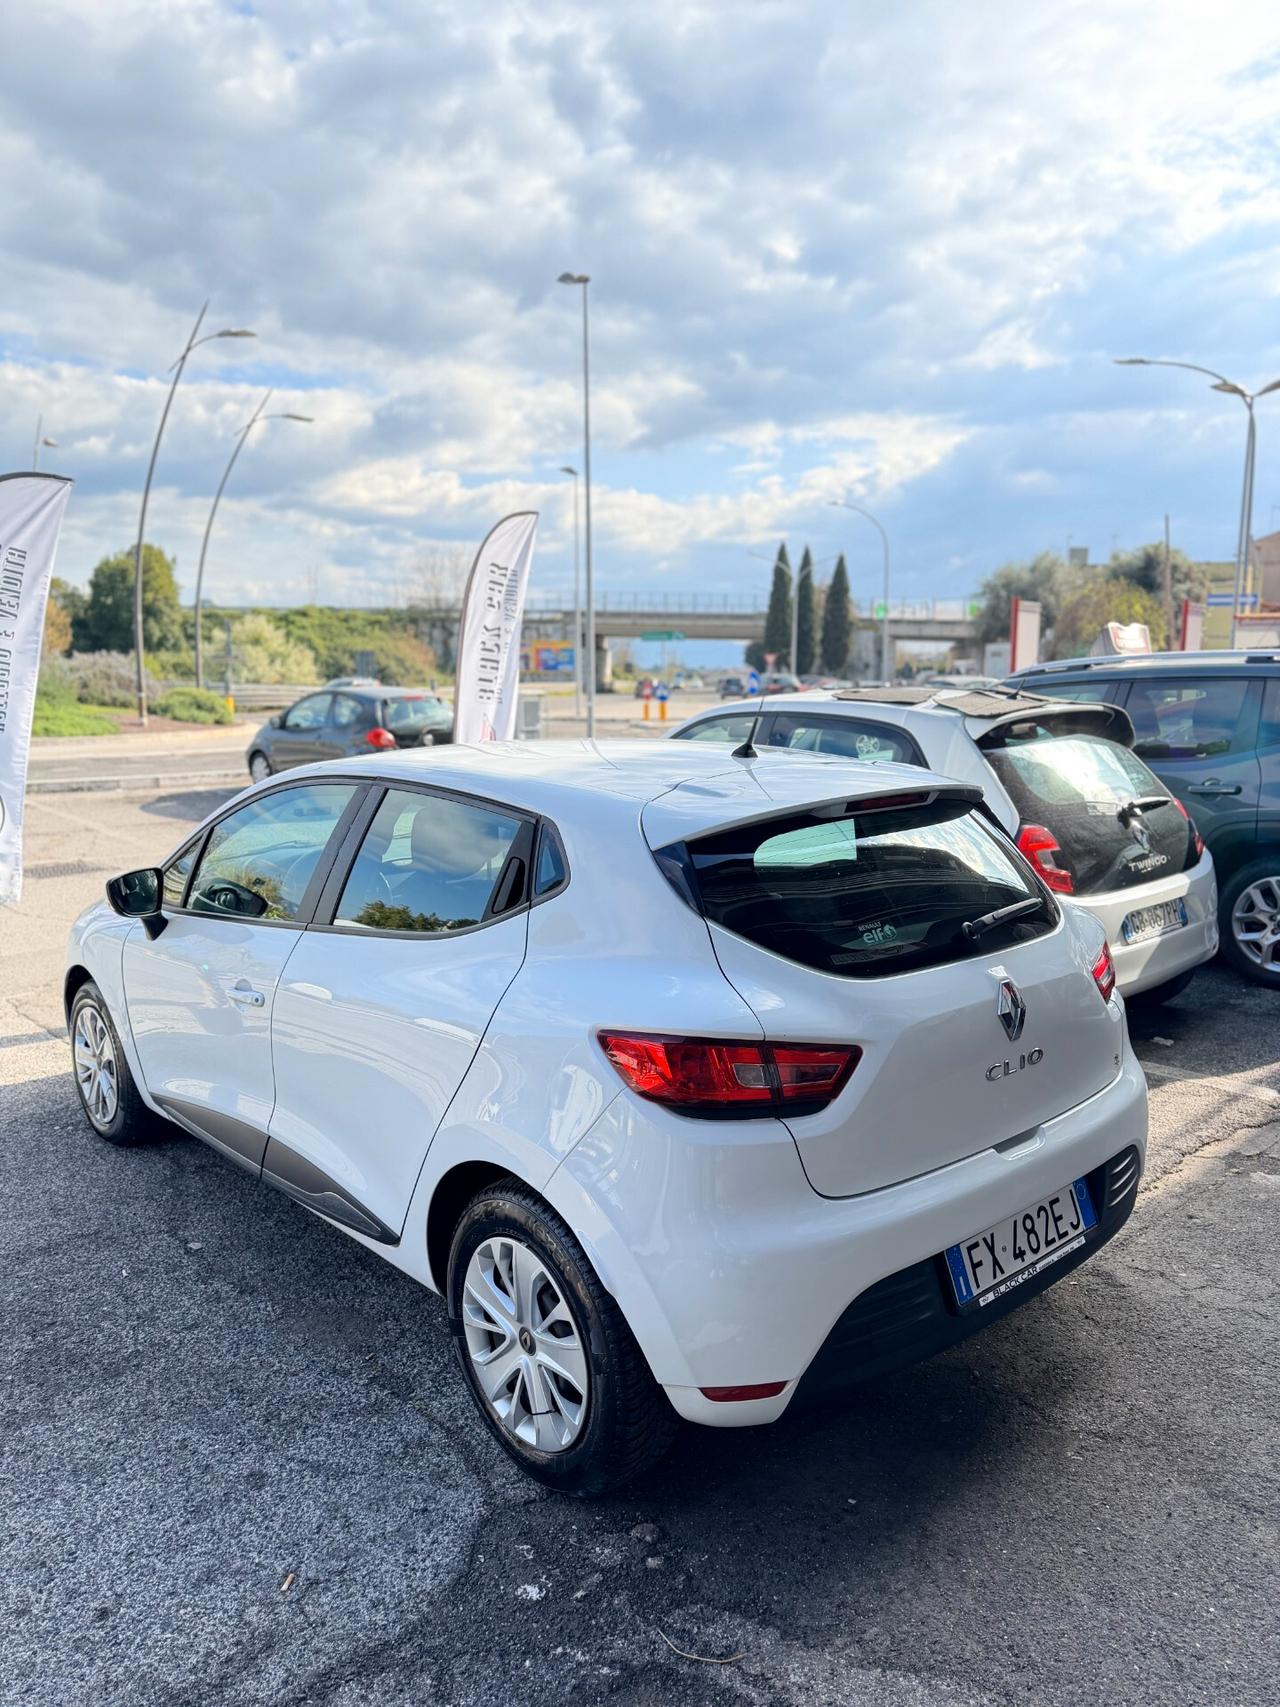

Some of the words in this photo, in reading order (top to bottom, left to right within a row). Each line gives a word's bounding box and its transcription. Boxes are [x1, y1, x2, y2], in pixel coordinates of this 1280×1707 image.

[483, 562, 508, 612] CAR
[473, 625, 502, 703] BLACK
[1129, 854, 1167, 872] TWINGO
[863, 927, 884, 943] elf
[985, 1047, 1044, 1081] CLIO
[966, 1232, 1005, 1289] FX
[1013, 1188, 1081, 1262] 482EJ
[992, 1277, 1020, 1298] BLACK
[1020, 1266, 1038, 1281] CAR
